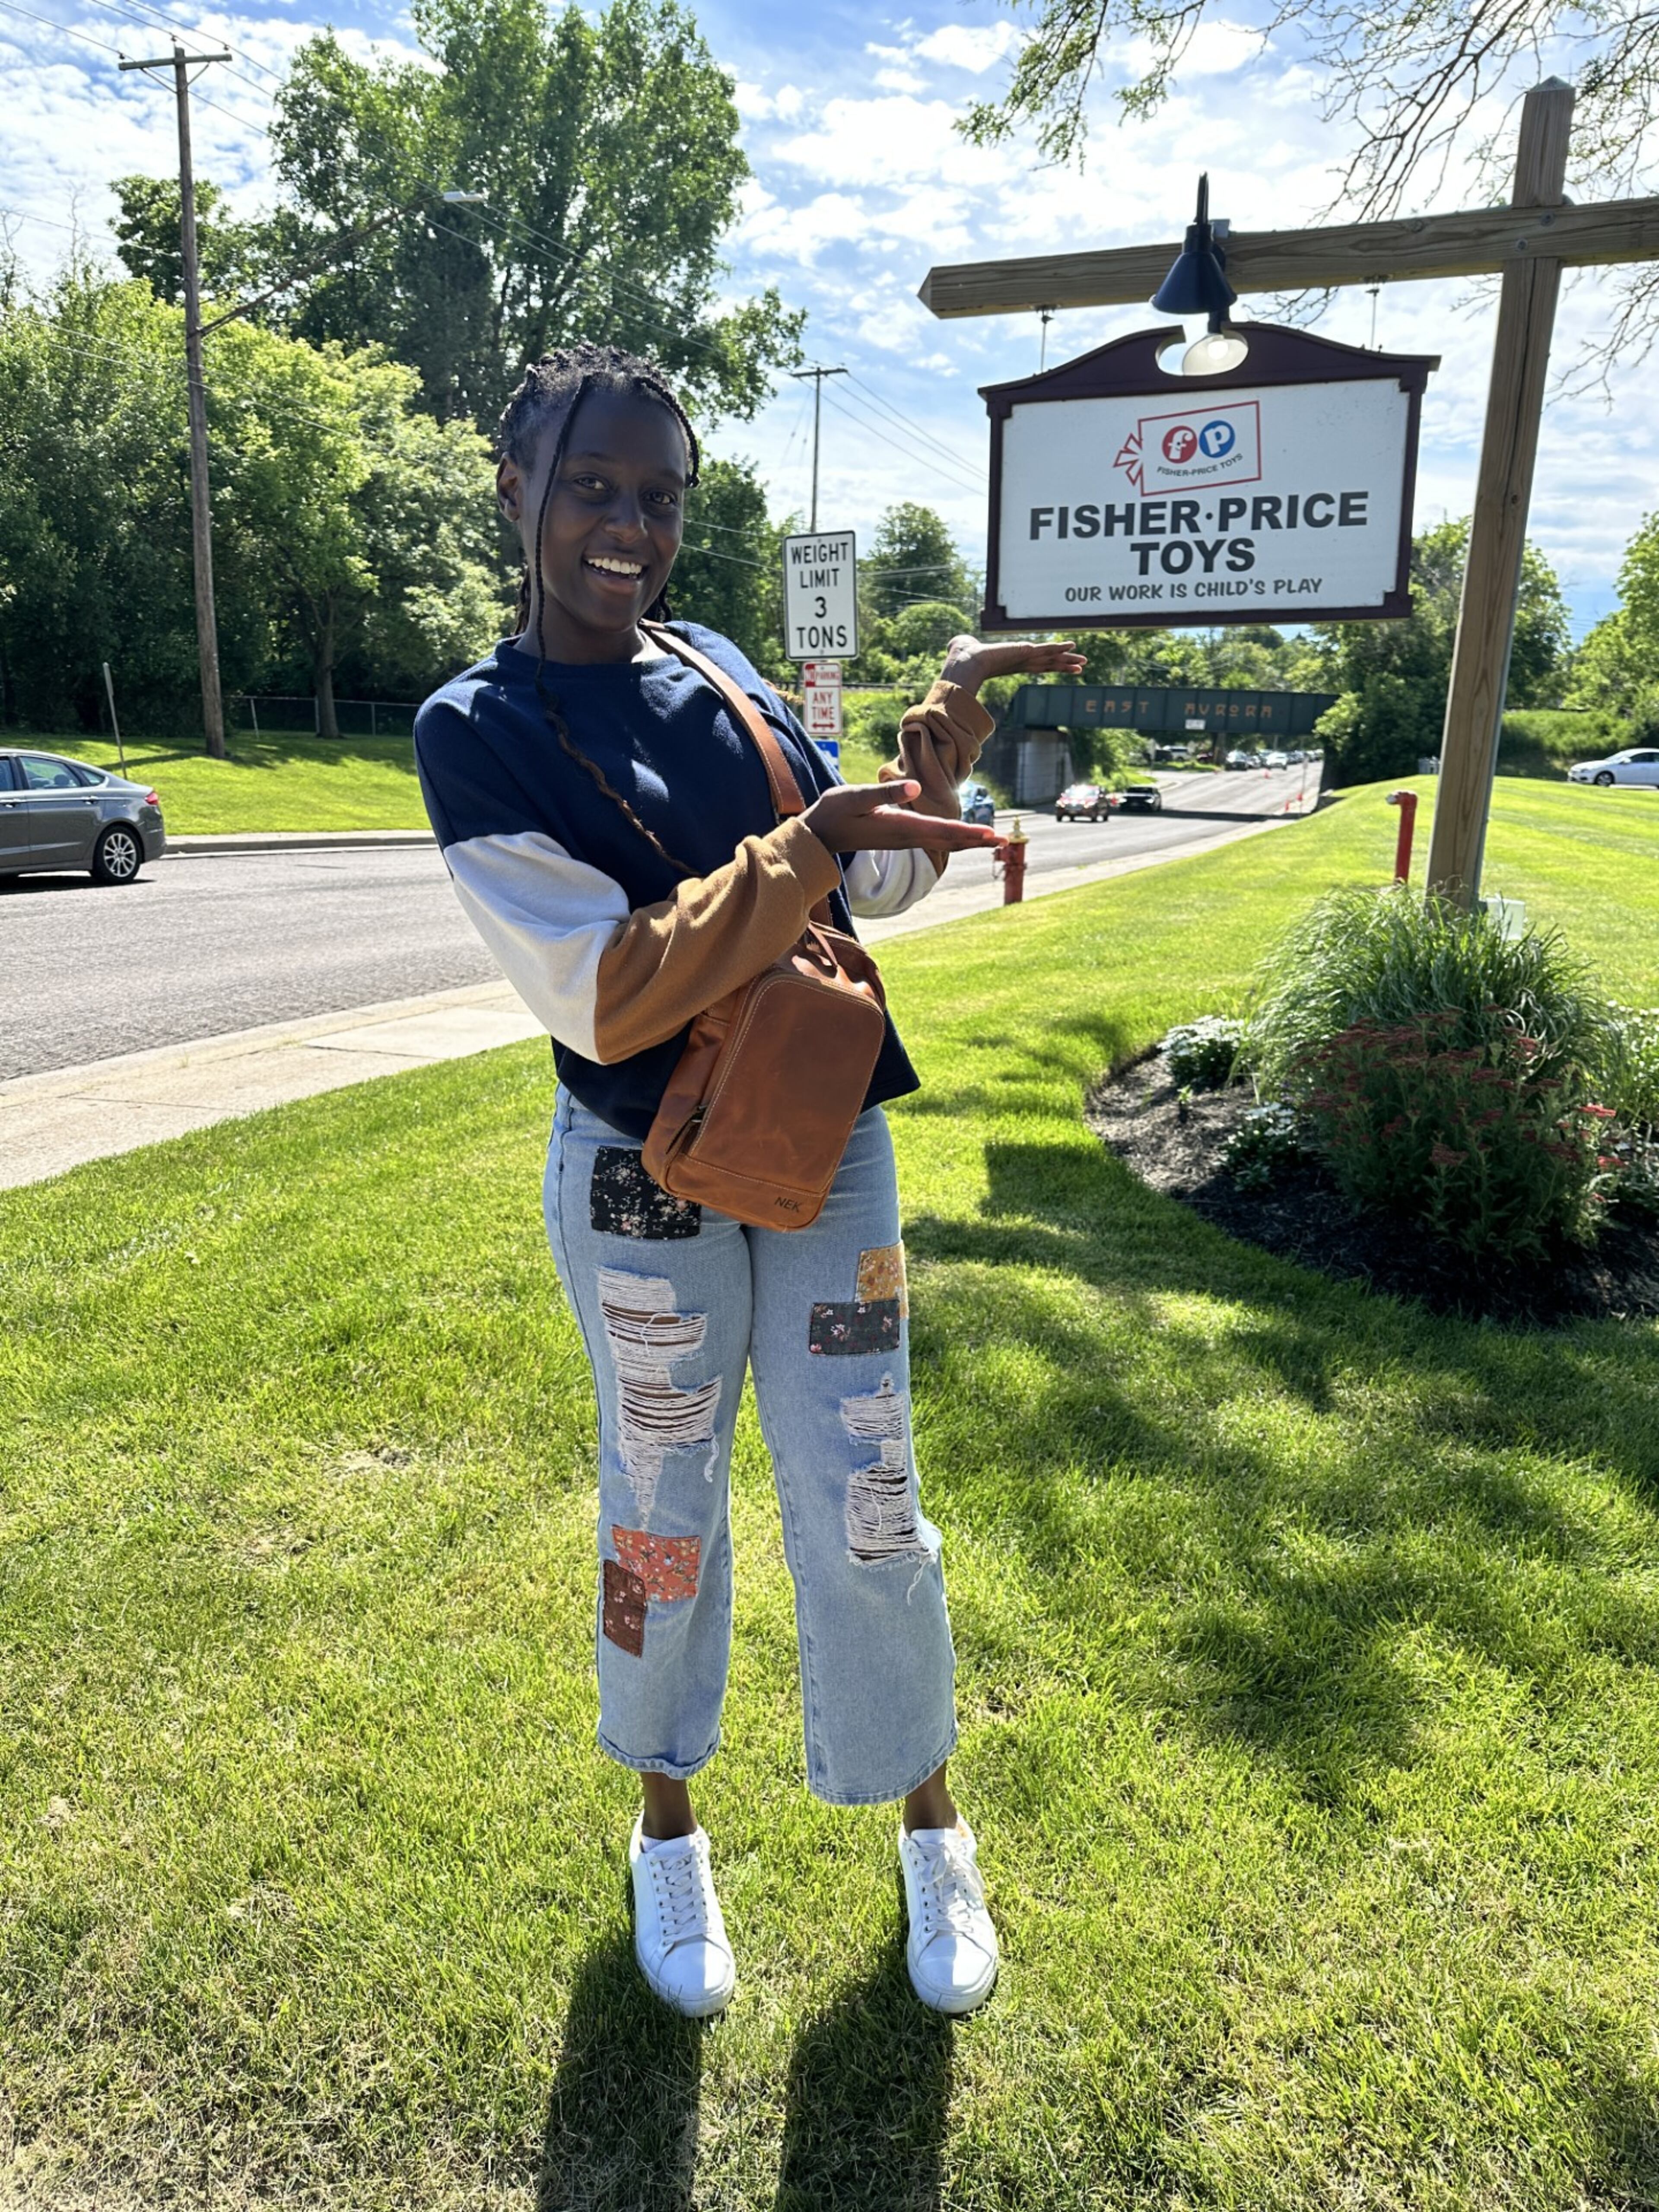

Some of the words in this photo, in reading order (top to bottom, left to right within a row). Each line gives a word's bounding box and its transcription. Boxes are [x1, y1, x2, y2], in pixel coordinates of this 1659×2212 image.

[1157, 464, 1217, 476] FISHER-PRICE
[1220, 453, 1243, 469] TOYS
[791, 542, 849, 564] WEIGHT
[1130, 538, 1255, 575] TOYS
[800, 568, 840, 588] LIMIT
[1065, 586, 1101, 602] OUR
[1109, 584, 1163, 599] WORK
[1170, 582, 1187, 598] IS
[1194, 579, 1265, 597] CHILD'S
[1273, 578, 1323, 594] PLAY
[815, 596, 827, 619] 3
[796, 625, 848, 649] TONS
[812, 692, 833, 704] ANY
[1085, 700, 1149, 714] EAST
[812, 706, 835, 720] TIME
[774, 1196, 802, 1213] NEK
